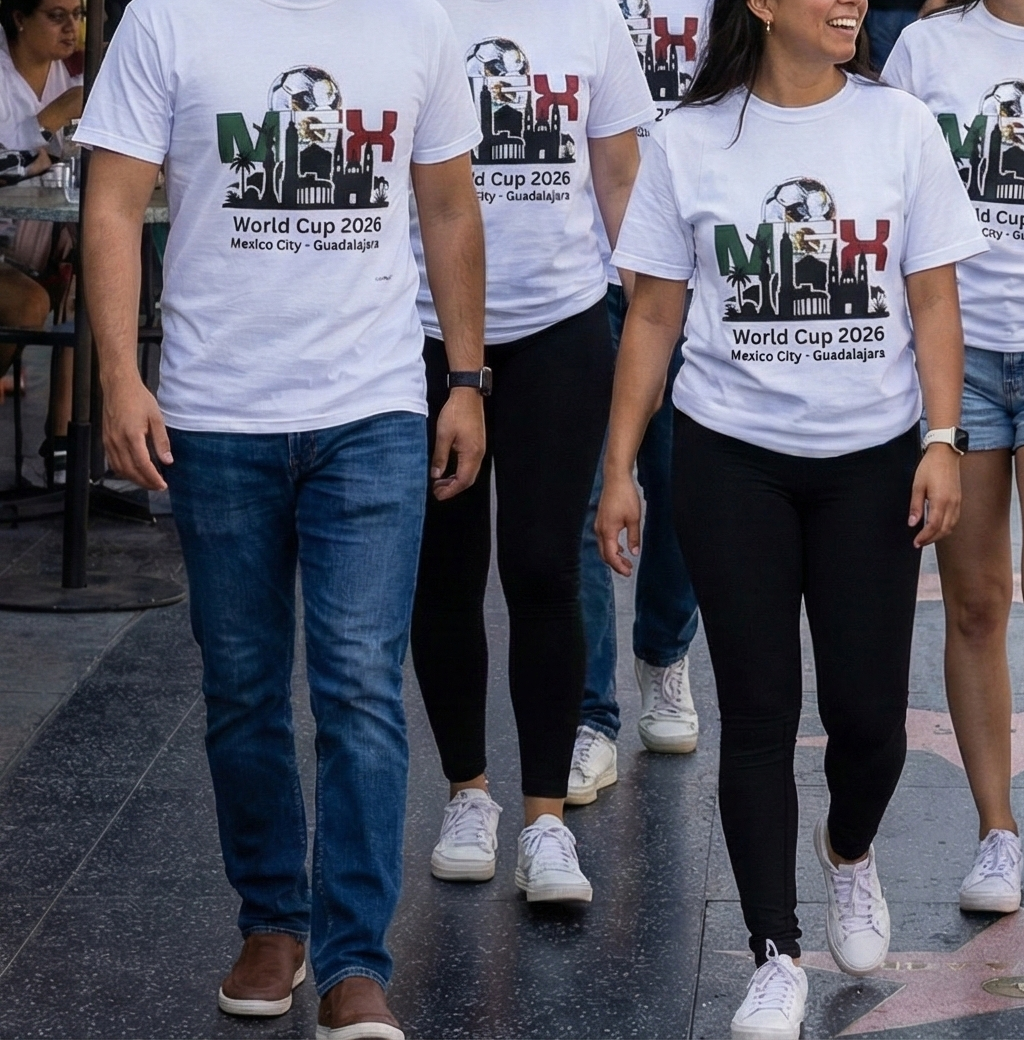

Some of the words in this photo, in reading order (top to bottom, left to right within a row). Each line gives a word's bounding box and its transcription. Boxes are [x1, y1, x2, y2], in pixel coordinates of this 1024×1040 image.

[491, 171, 526, 189] Cup
[531, 171, 570, 186] 2026
[233, 216, 290, 234] World
[296, 217, 335, 238] Cup
[341, 216, 382, 233] 2026
[276, 240, 302, 254] City
[733, 328, 788, 345] World
[794, 328, 833, 348] Cup
[838, 326, 885, 343] 2026
[731, 349, 773, 362] Mexico
